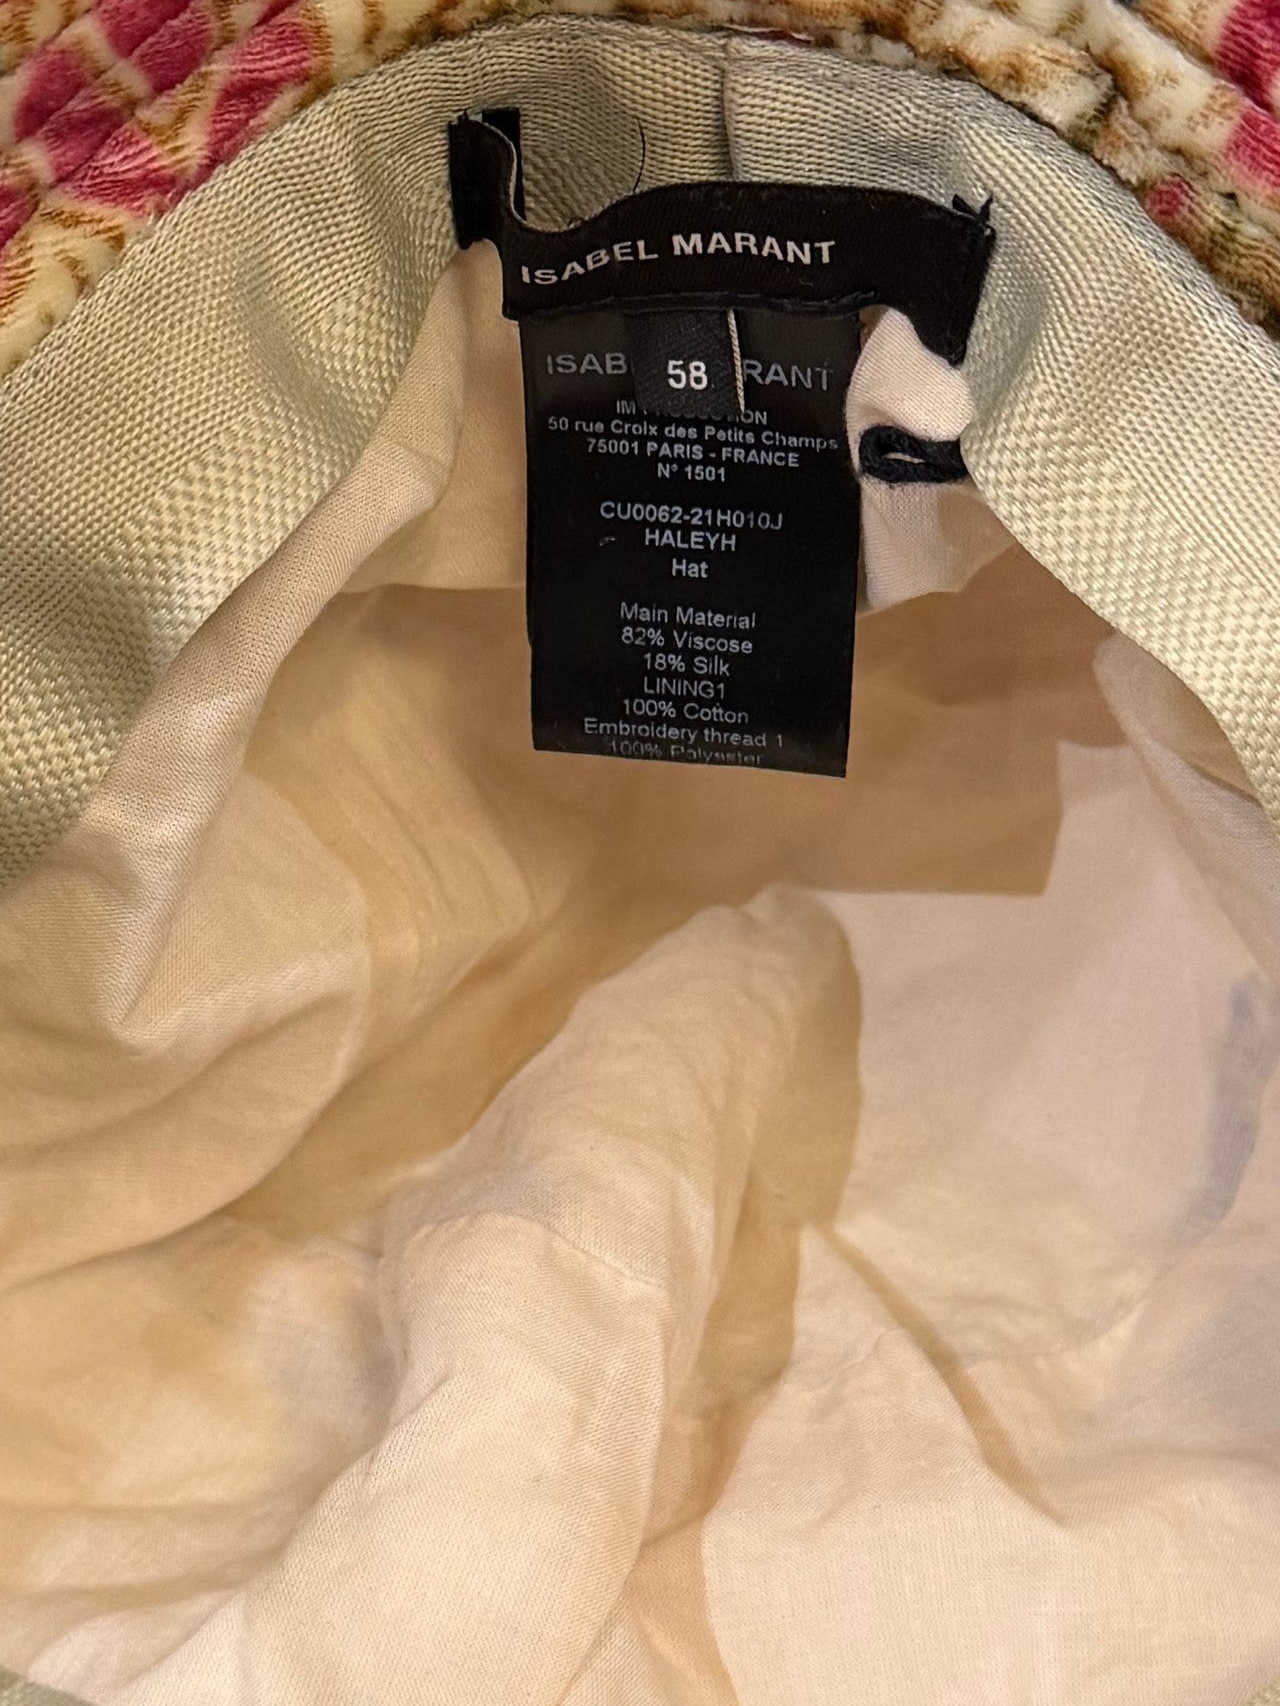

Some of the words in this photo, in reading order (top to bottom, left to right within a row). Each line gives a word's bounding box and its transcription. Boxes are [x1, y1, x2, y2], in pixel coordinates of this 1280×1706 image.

[521, 239, 659, 286] ISABEL
[672, 232, 836, 266] MARANT
[546, 352, 628, 376] ISAB
[742, 359, 833, 391] RANT
[666, 359, 708, 390] 58
[547, 416, 569, 431] 50
[574, 420, 605, 434] rue
[610, 420, 658, 437] Croix
[664, 423, 699, 440] des
[704, 425, 755, 445] Petits
[761, 430, 839, 451] Champs
[586, 438, 640, 456] 75001
[646, 442, 704, 461] PARIS
[721, 449, 801, 468] FRANCE
[684, 464, 727, 483] 1501
[599, 500, 784, 531] CU0062-21H010J
[644, 528, 737, 552] HALEYH
[671, 558, 709, 578] Hat
[620, 601, 669, 623] Main
[675, 605, 757, 631] Material
[621, 626, 665, 647] 82%
[672, 630, 754, 654] Viscose
[643, 652, 686, 673] 18%
[692, 654, 731, 677] Silk
[643, 676, 726, 700] LINING1
[622, 699, 677, 719] 100%
[683, 702, 750, 725] Cotton
[583, 717, 699, 744] Embroidery
[703, 726, 768, 748] thread
[776, 734, 784, 748] 1
[610, 739, 663, 758] 100%
